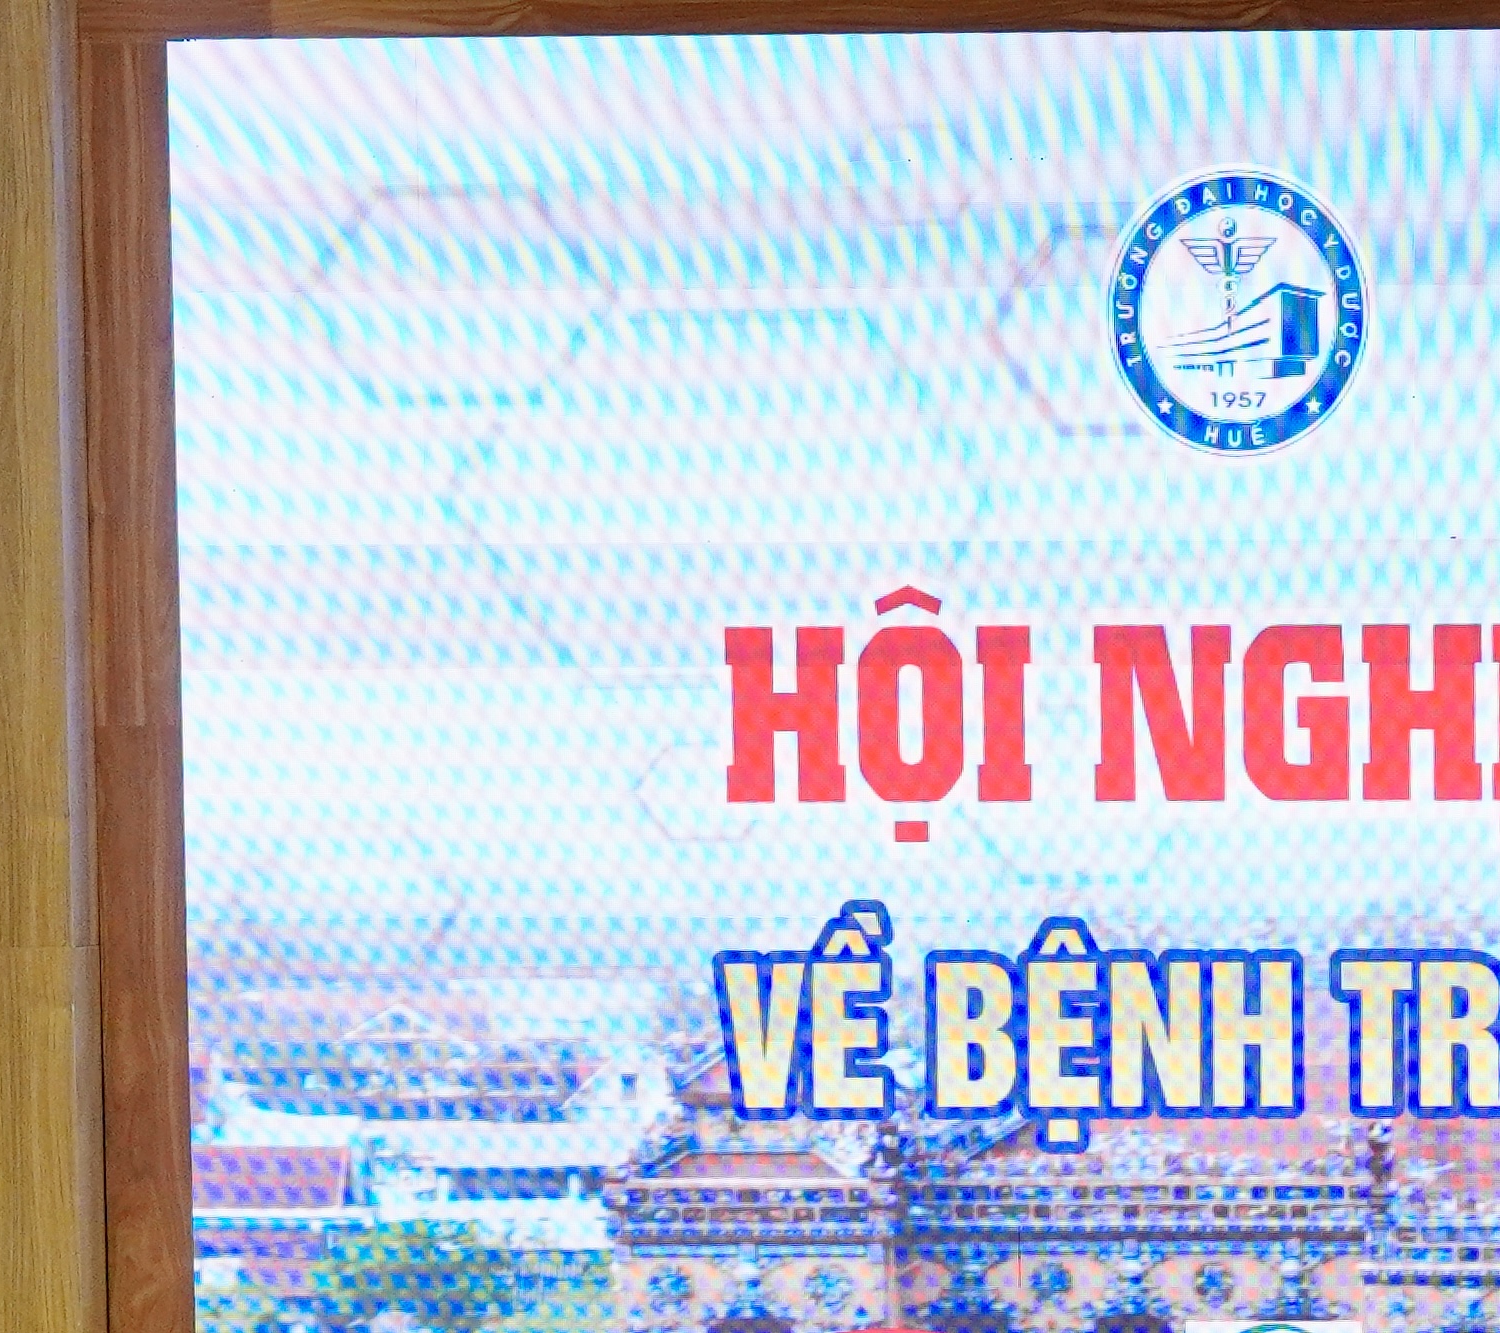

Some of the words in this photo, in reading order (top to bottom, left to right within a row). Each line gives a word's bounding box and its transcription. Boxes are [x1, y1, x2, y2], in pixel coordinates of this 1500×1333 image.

[1205, 421, 1268, 447] HUẾ
[1211, 392, 1267, 408] 1957
[723, 587, 1035, 843] HỘI
[719, 902, 891, 1118] VỀ
[928, 919, 1294, 1146] BỆNH
